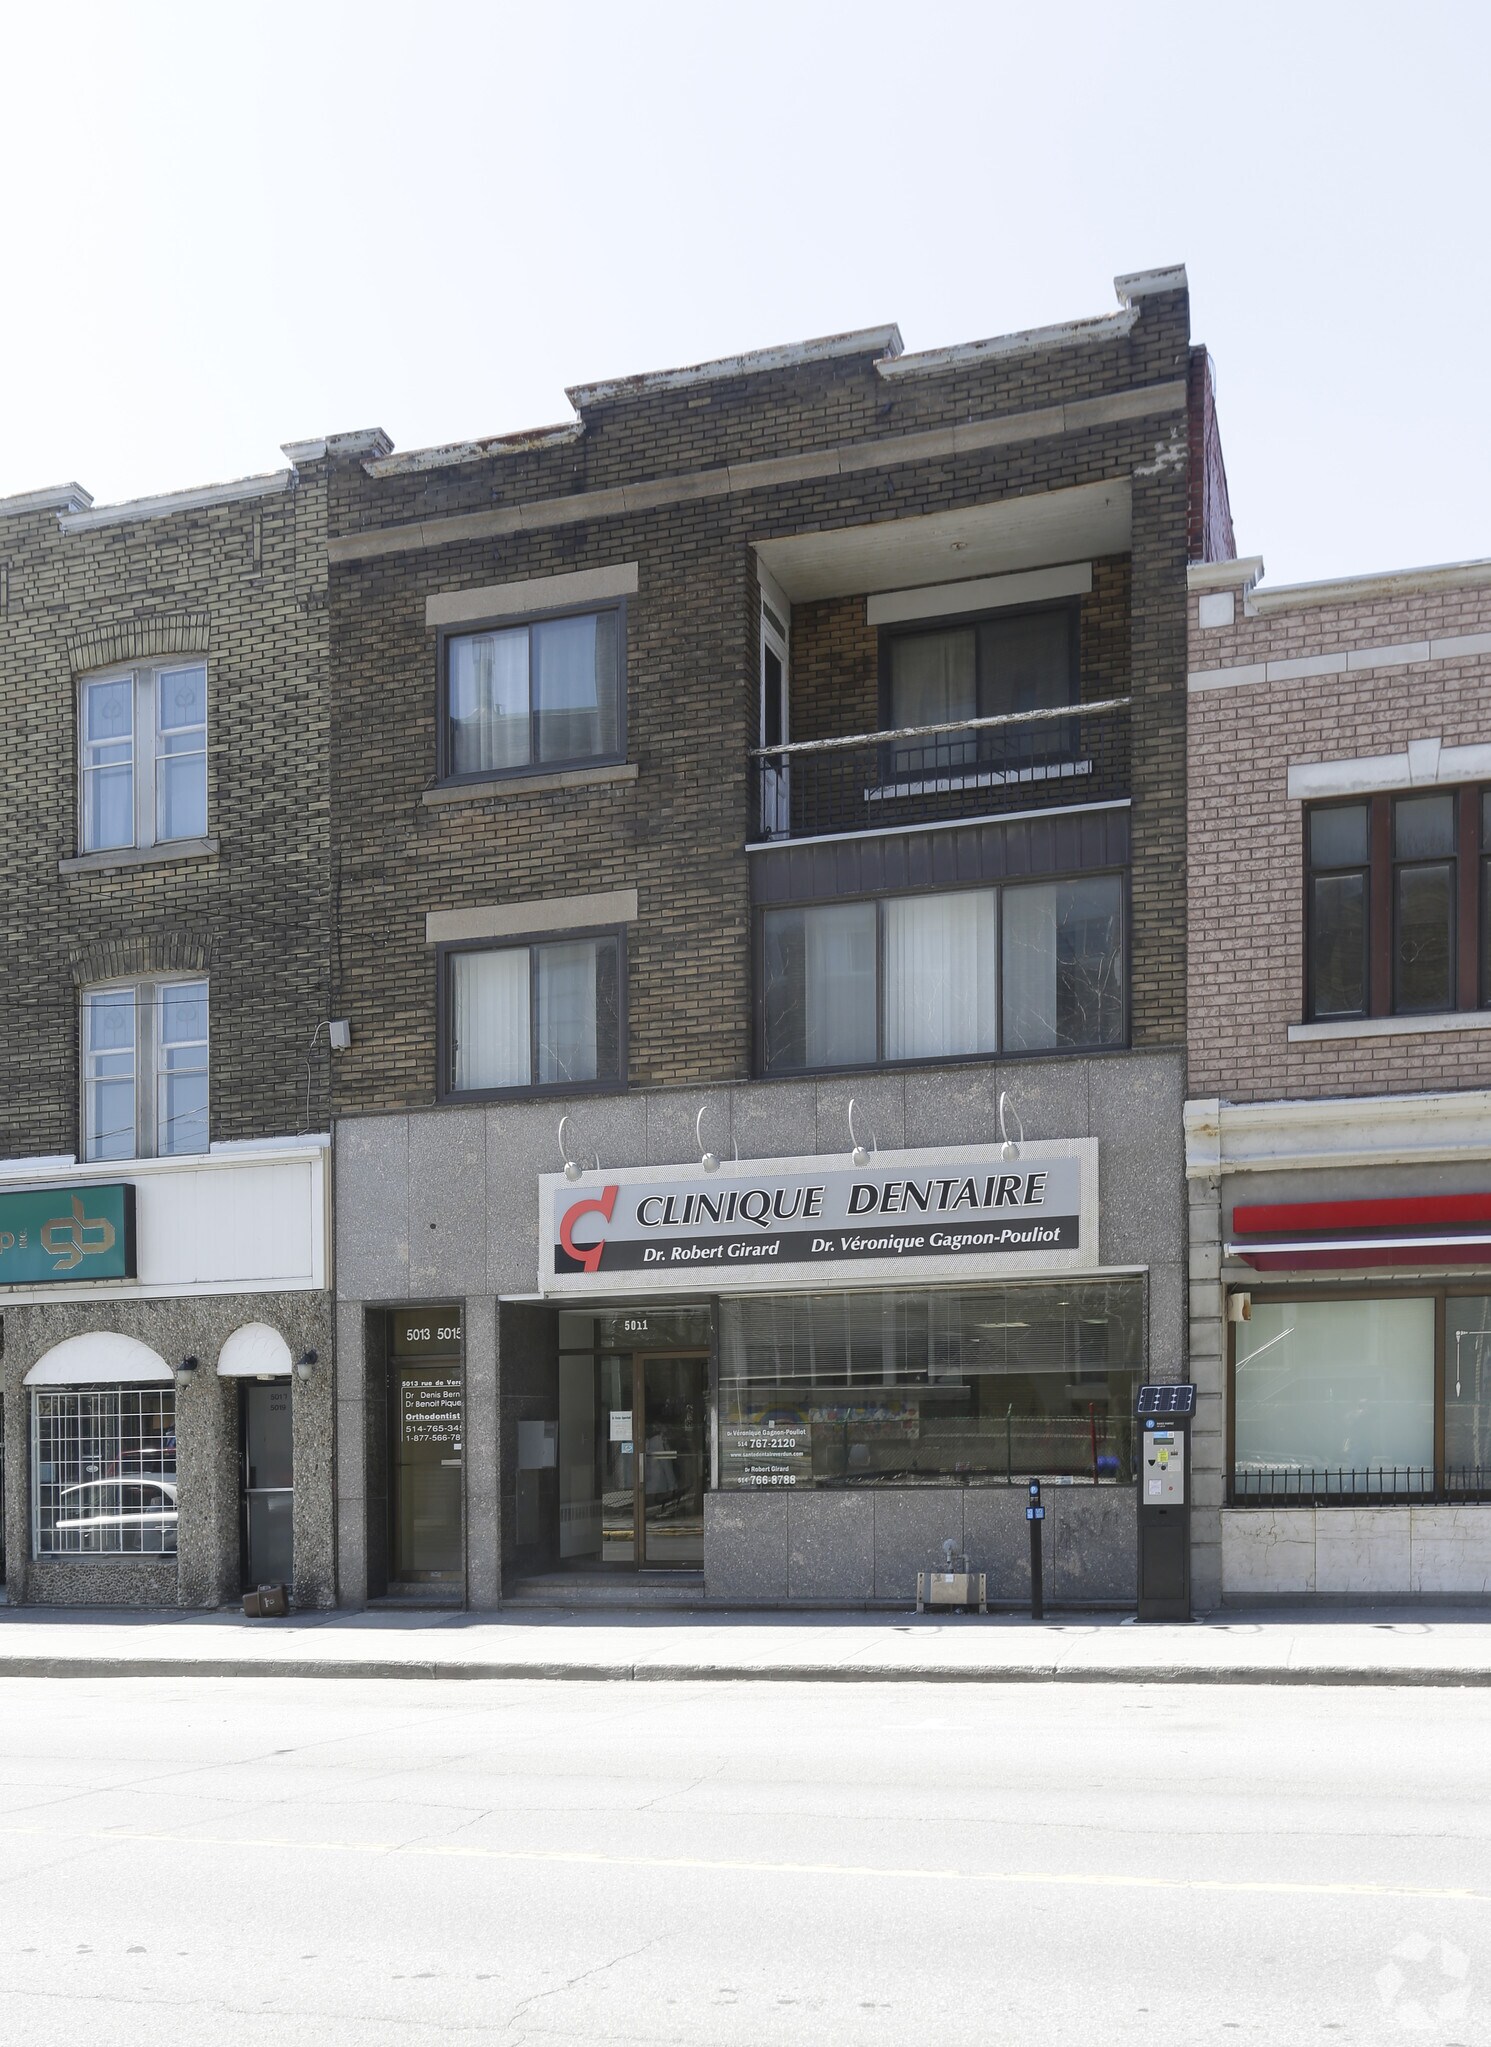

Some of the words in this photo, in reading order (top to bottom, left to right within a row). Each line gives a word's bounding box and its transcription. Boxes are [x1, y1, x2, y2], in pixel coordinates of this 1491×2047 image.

[635, 1185, 825, 1229] CLINIQUE
[846, 1171, 1048, 1216] DENTAIRE
[811, 1238, 835, 1252] Dr.
[840, 1234, 925, 1253] Véronique
[929, 1226, 1061, 1250] Gagnon-Pouliot
[643, 1248, 666, 1262] Dr.
[670, 1246, 724, 1261] Robert
[727, 1240, 780, 1257] Girard
[624, 1319, 648, 1331] 5011
[406, 1328, 431, 1341] 5013
[437, 1327, 461, 1340] 5015
[405, 1391, 415, 1399] Dr
[420, 1391, 441, 1399] Denis
[405, 1400, 414, 1408] Dr
[415, 1400, 440, 1408] Benoit
[762, 1429, 806, 1437] Gagnon-Pouliot
[749, 1438, 796, 1449] 767-2120
[750, 1474, 796, 1485] 766-8788
